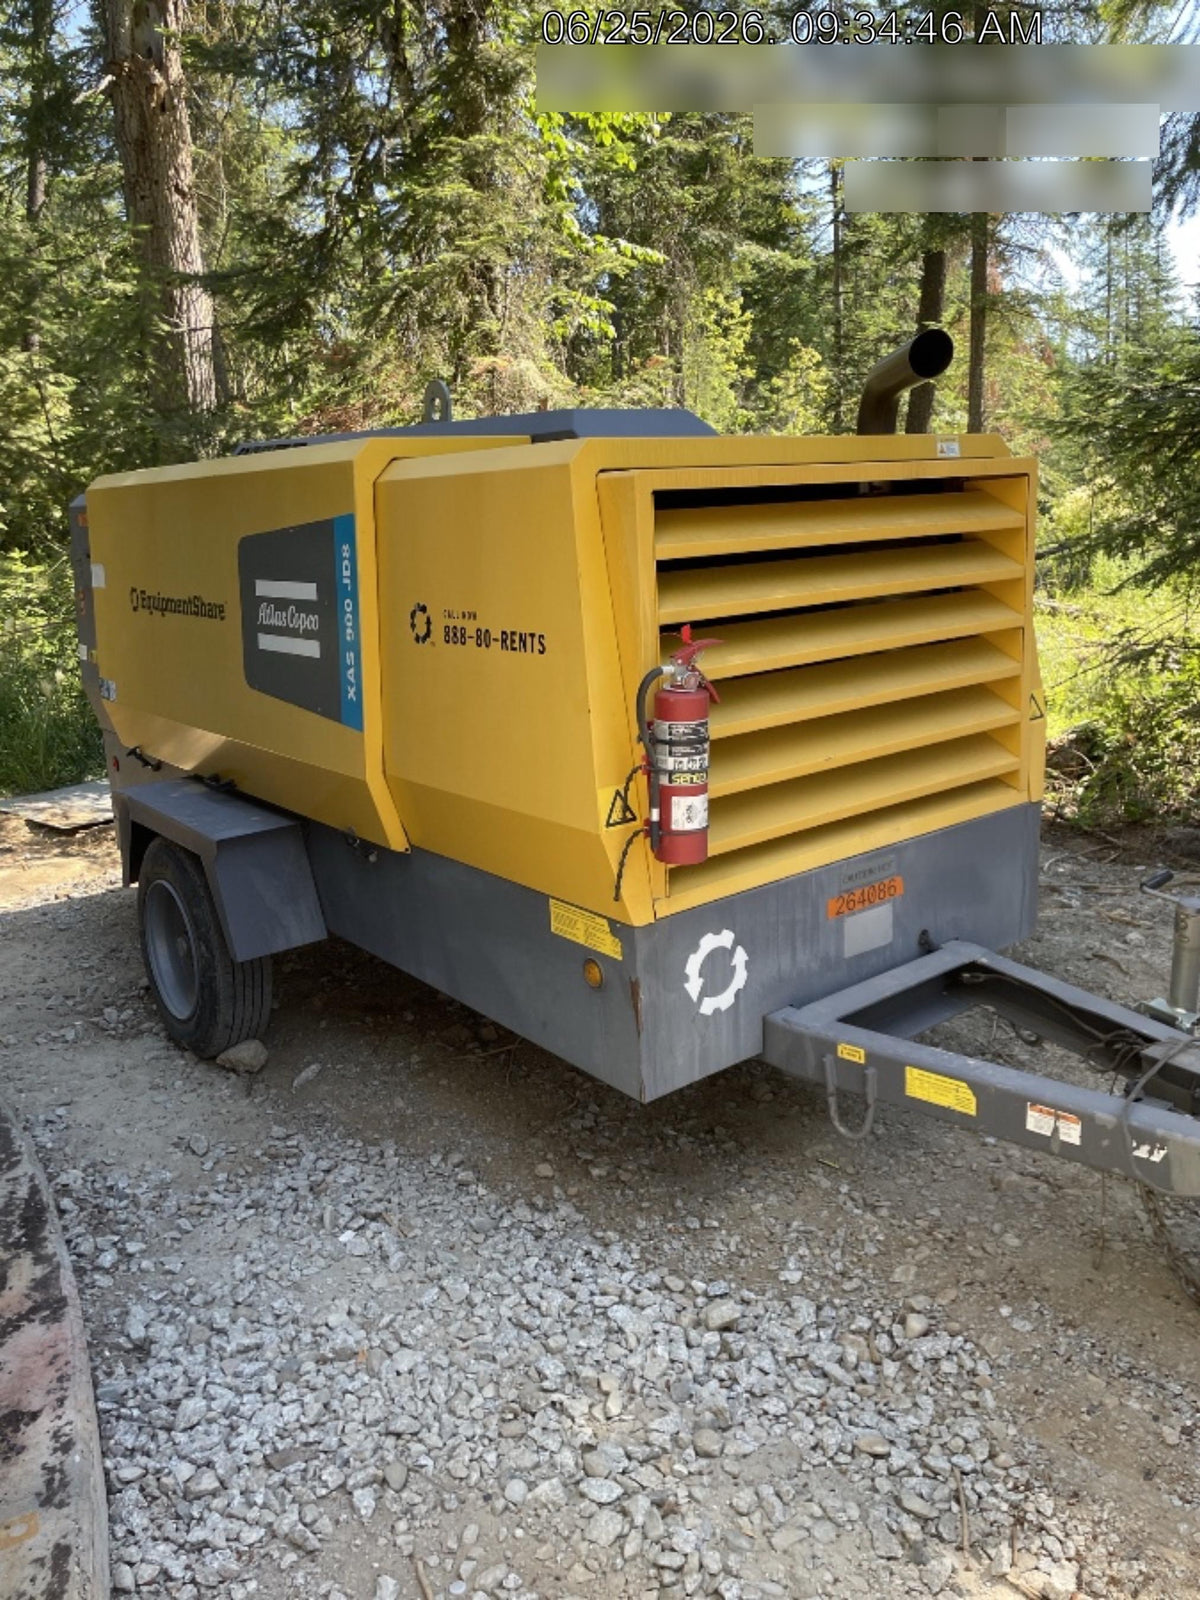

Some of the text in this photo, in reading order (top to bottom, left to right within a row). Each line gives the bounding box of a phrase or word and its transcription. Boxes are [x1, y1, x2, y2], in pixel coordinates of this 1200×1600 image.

[139, 589, 225, 621] EquipmentShare
[257, 602, 319, 635] Atlas Copco
[341, 543, 356, 702] XAS 900 JD8
[443, 625, 547, 655] 888-80-RENTS
[834, 878, 897, 916] 264086
